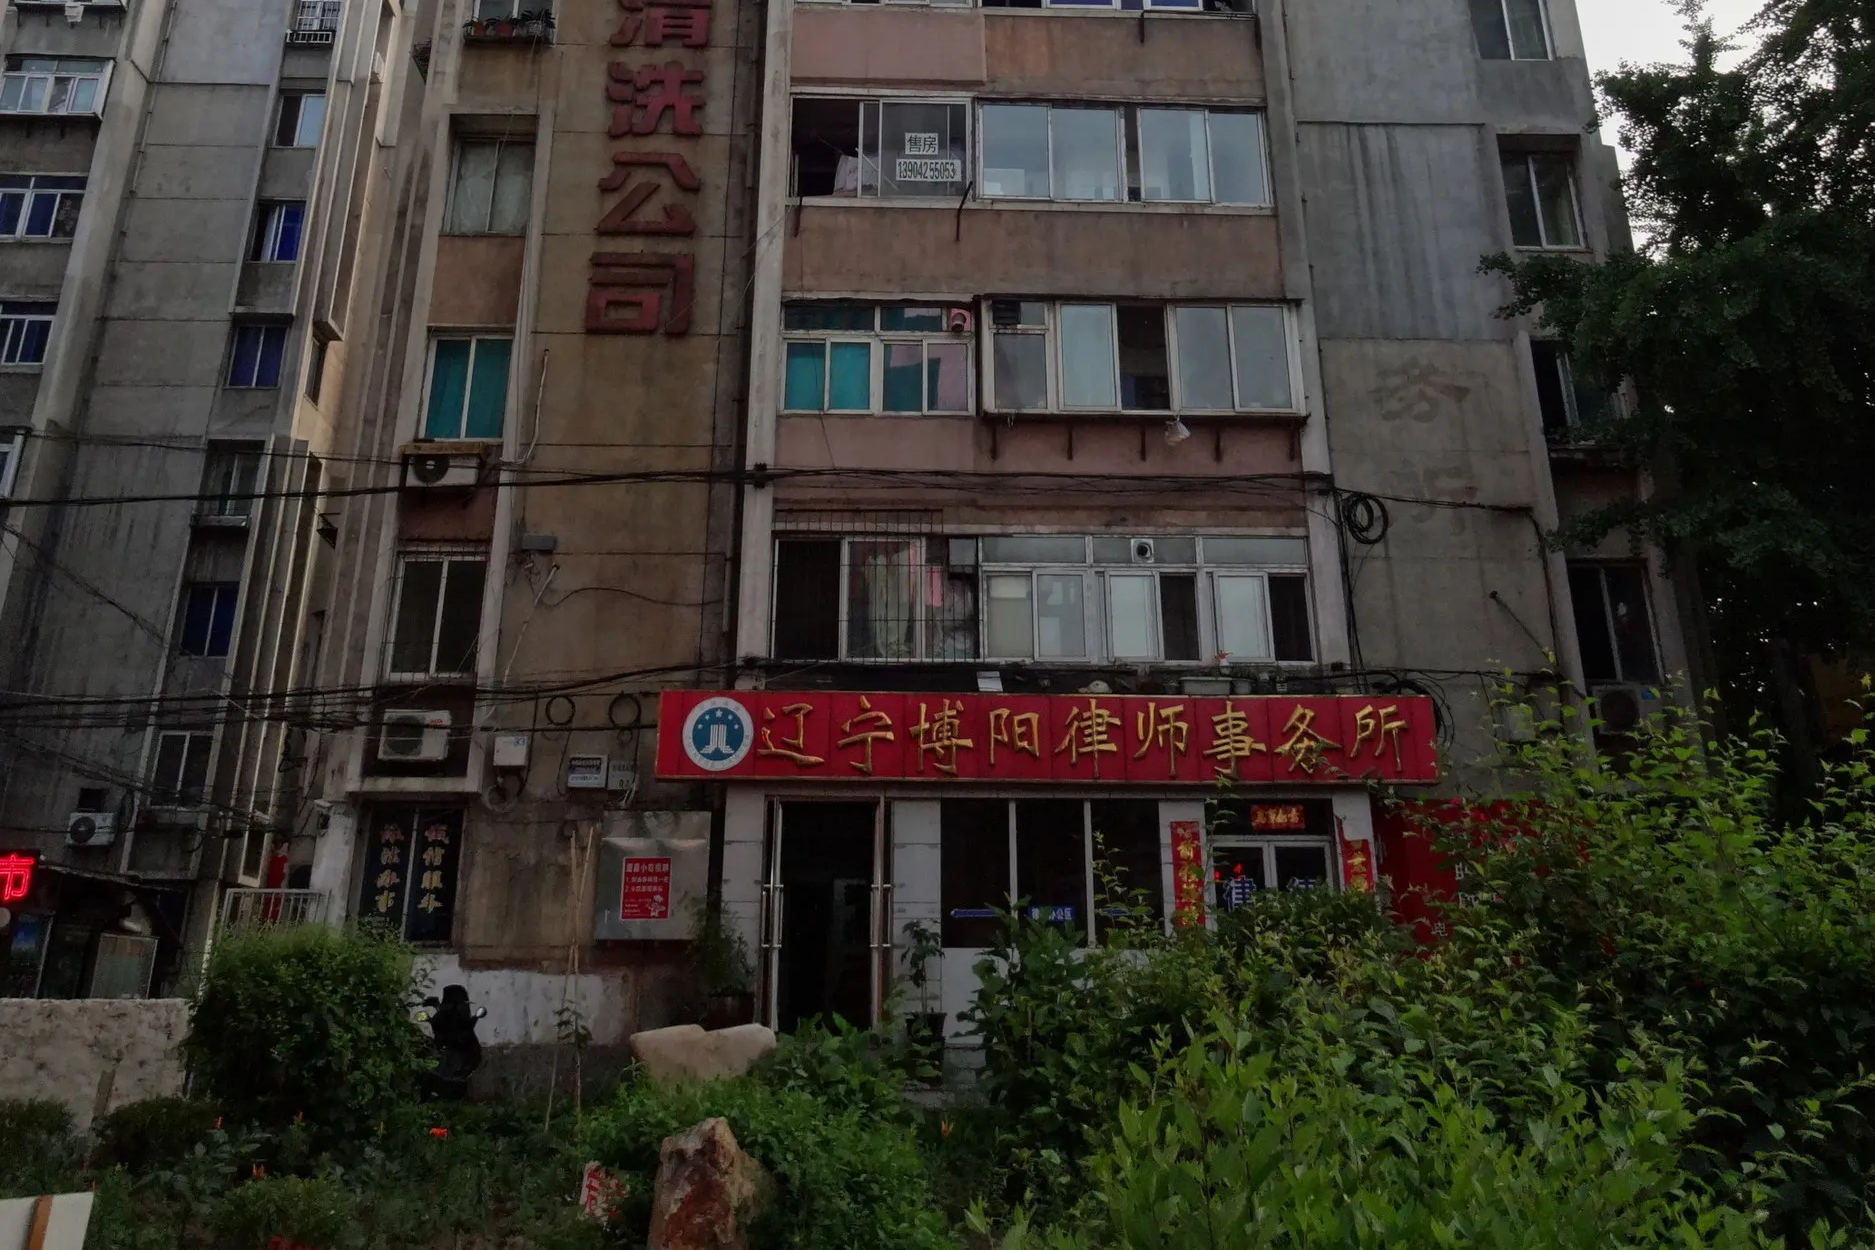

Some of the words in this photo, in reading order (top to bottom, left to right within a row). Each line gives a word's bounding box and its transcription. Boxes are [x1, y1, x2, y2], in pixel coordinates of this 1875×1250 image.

[907, 135, 937, 153] 售房
[898, 161, 956, 179] 13904255053
[755, 695, 1409, 777] 辽宁博阳律师事务所
[0, 852, 36, 902] 市
